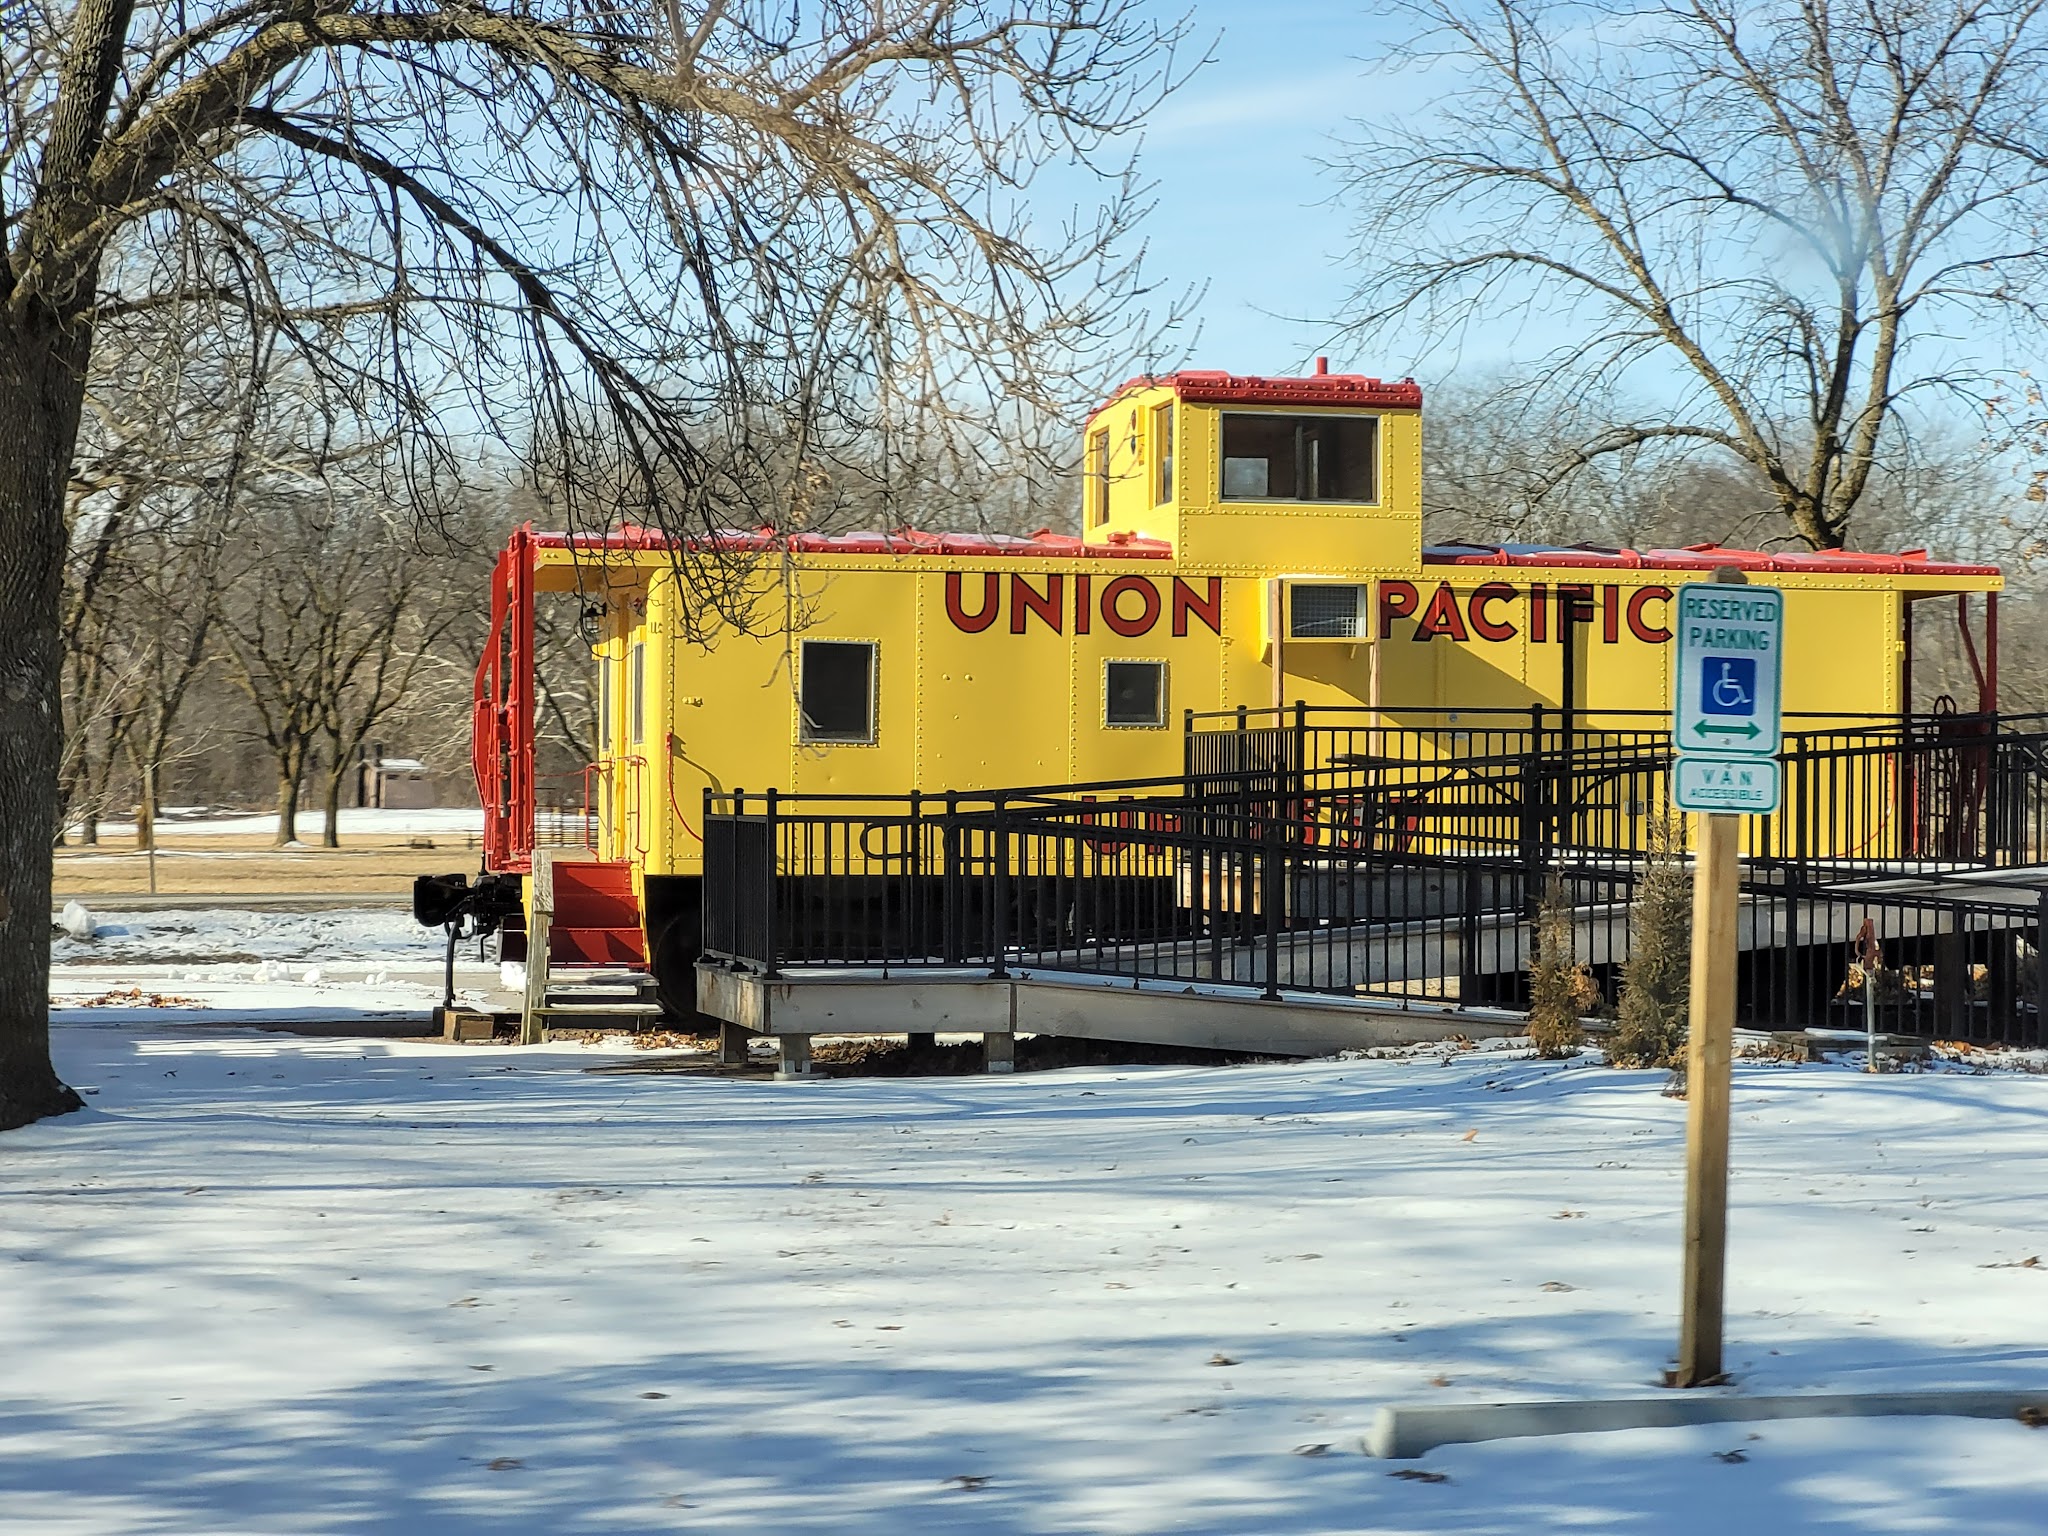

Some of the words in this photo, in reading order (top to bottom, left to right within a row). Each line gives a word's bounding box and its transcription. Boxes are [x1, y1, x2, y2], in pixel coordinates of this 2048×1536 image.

[945, 571, 1222, 638] UNION
[1379, 579, 1675, 644] PACIFIC
[1685, 597, 1777, 622] RESERVED
[1689, 626, 1770, 651] PARKING
[1701, 768, 1754, 786] VAN
[1688, 787, 1764, 801] ACCESSIBLE
